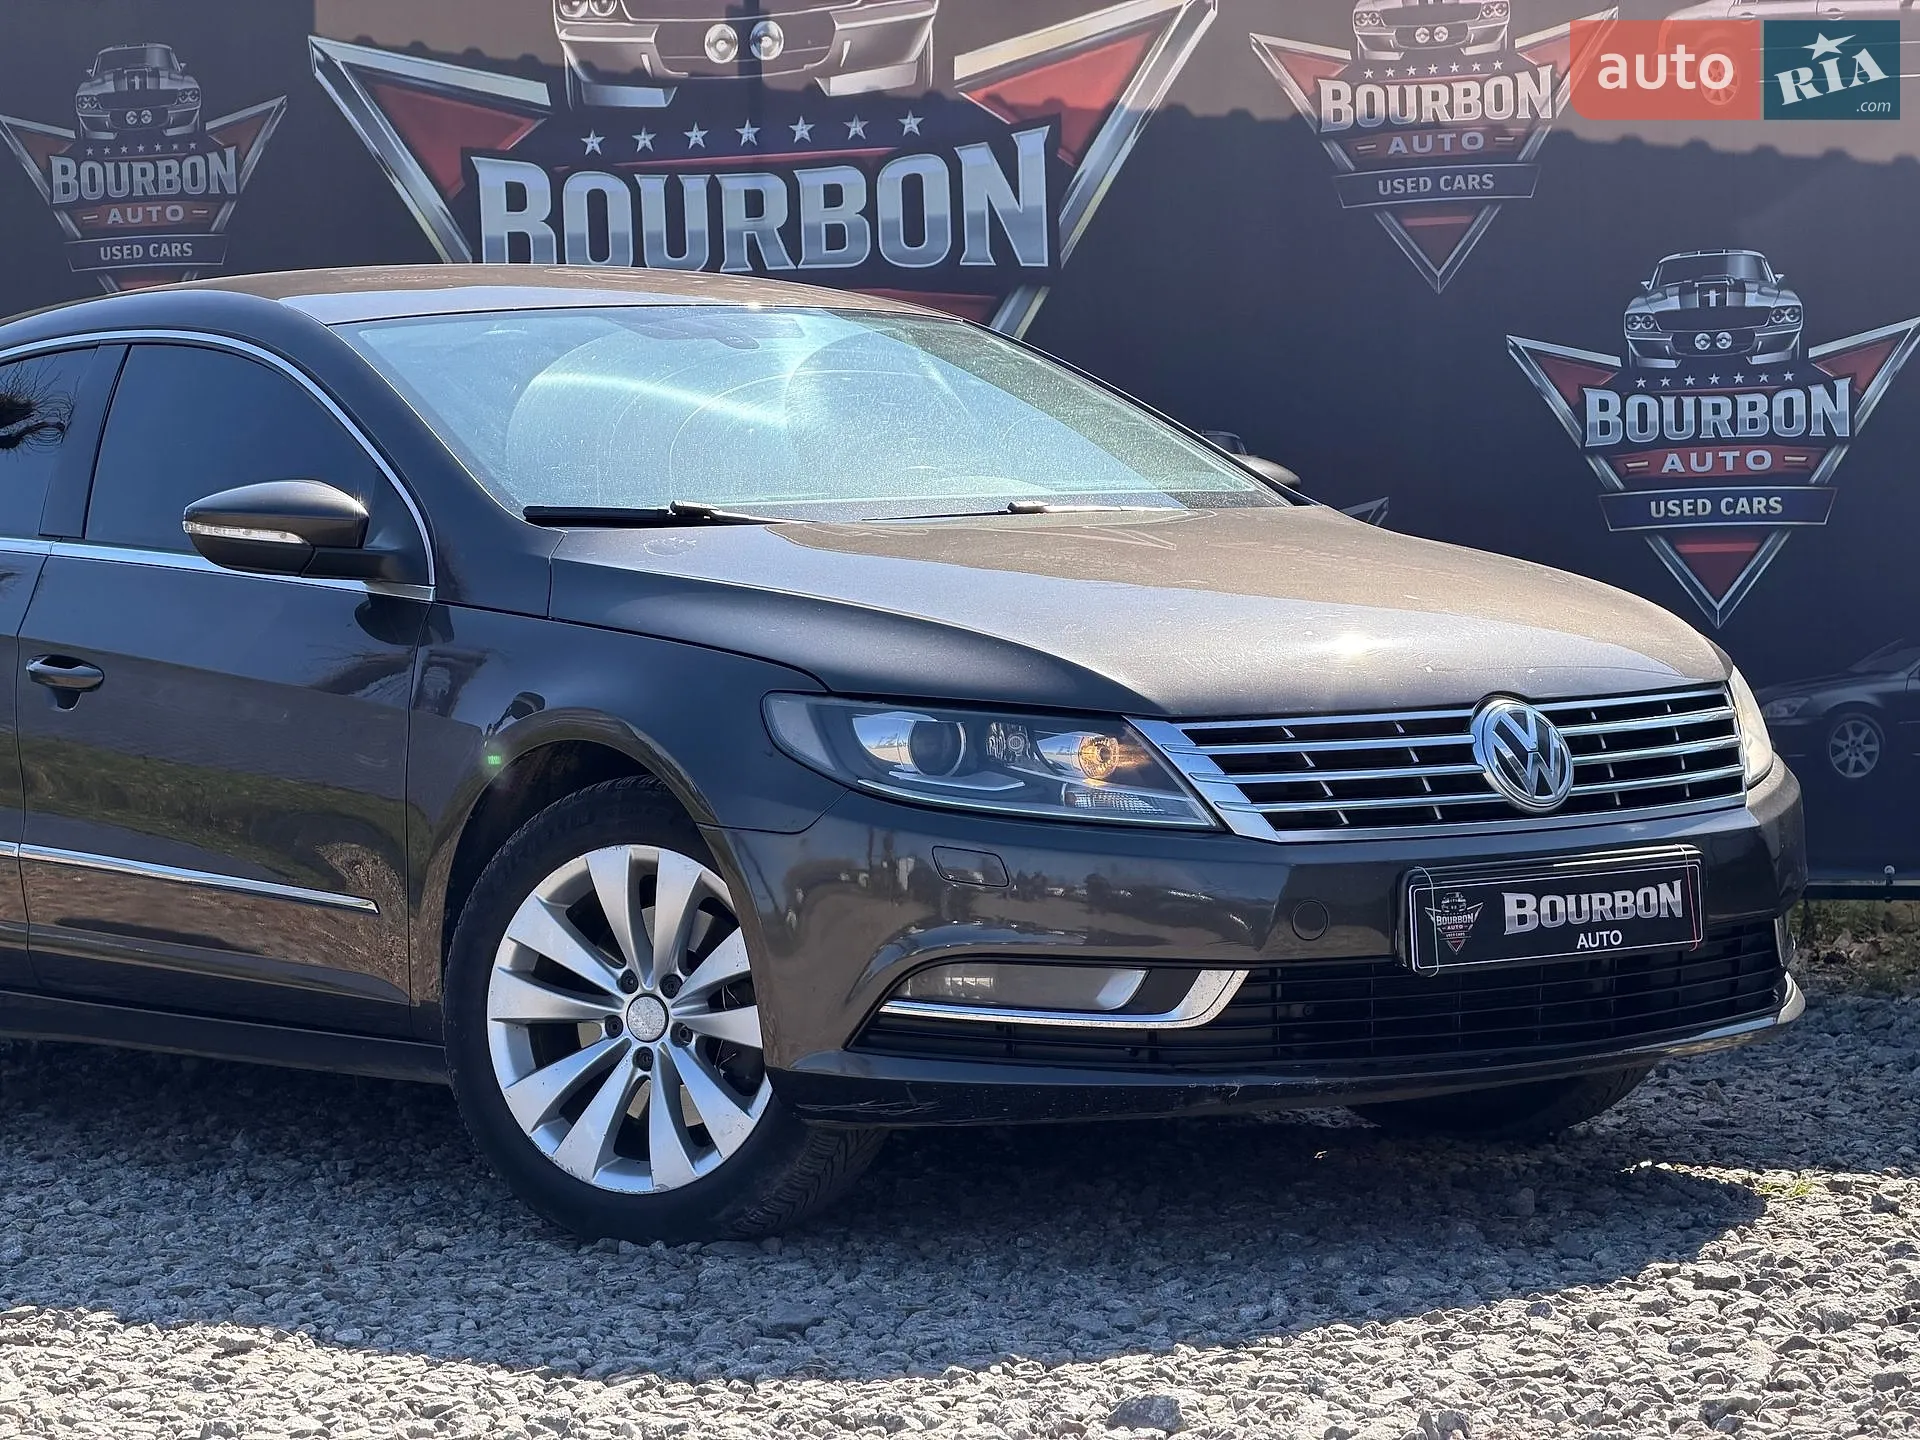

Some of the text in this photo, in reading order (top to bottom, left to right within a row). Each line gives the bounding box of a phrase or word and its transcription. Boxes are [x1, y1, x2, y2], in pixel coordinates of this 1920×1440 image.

[1317, 64, 1553, 132] BOURBON
[1387, 131, 1484, 155] AUTO
[49, 146, 236, 203] BOURBON
[1378, 173, 1495, 195] USED CARS
[470, 125, 1050, 272] BOURBON
[107, 205, 184, 224] AUTO
[100, 242, 193, 261] USED CARS
[1583, 377, 1851, 447] BOURBON
[1661, 449, 1773, 474] AUTO
[1650, 496, 1783, 518] USED CARS
[1501, 879, 1683, 936] BOURBON
[1576, 930, 1623, 950] AUTO
